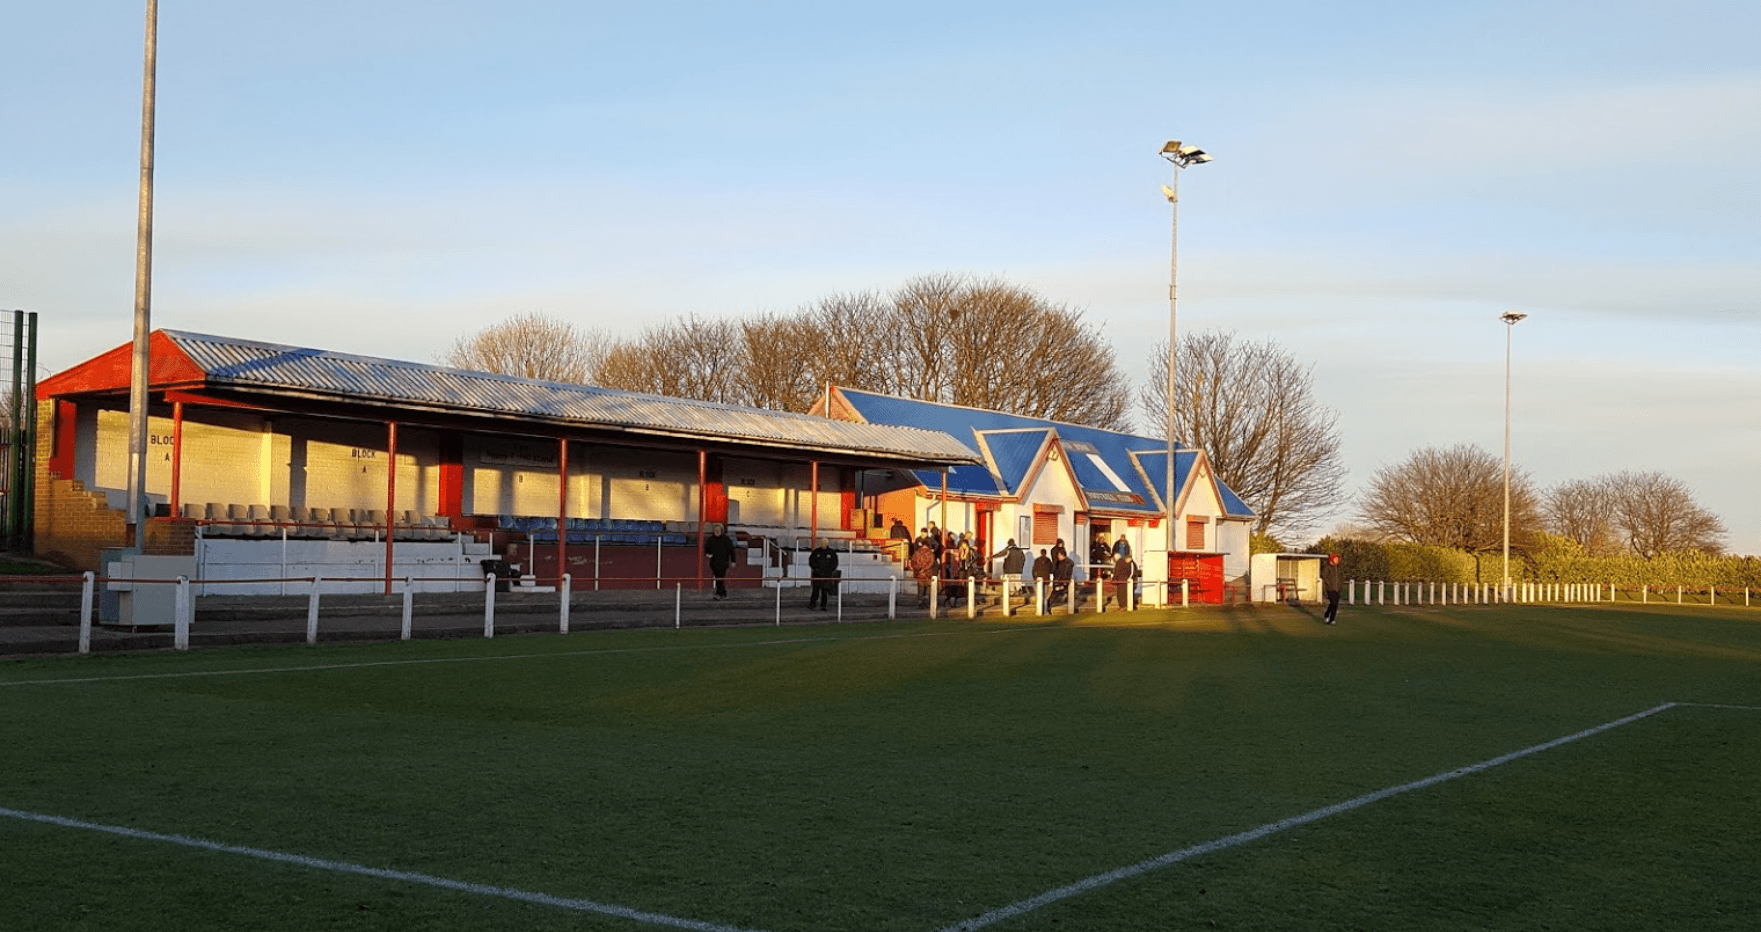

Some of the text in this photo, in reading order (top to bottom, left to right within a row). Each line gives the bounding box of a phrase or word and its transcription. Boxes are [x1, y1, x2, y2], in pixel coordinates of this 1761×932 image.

[151, 434, 174, 445] BLOC
[164, 452, 170, 461] A
[352, 449, 376, 459] BLOCK
[362, 465, 367, 474] A
